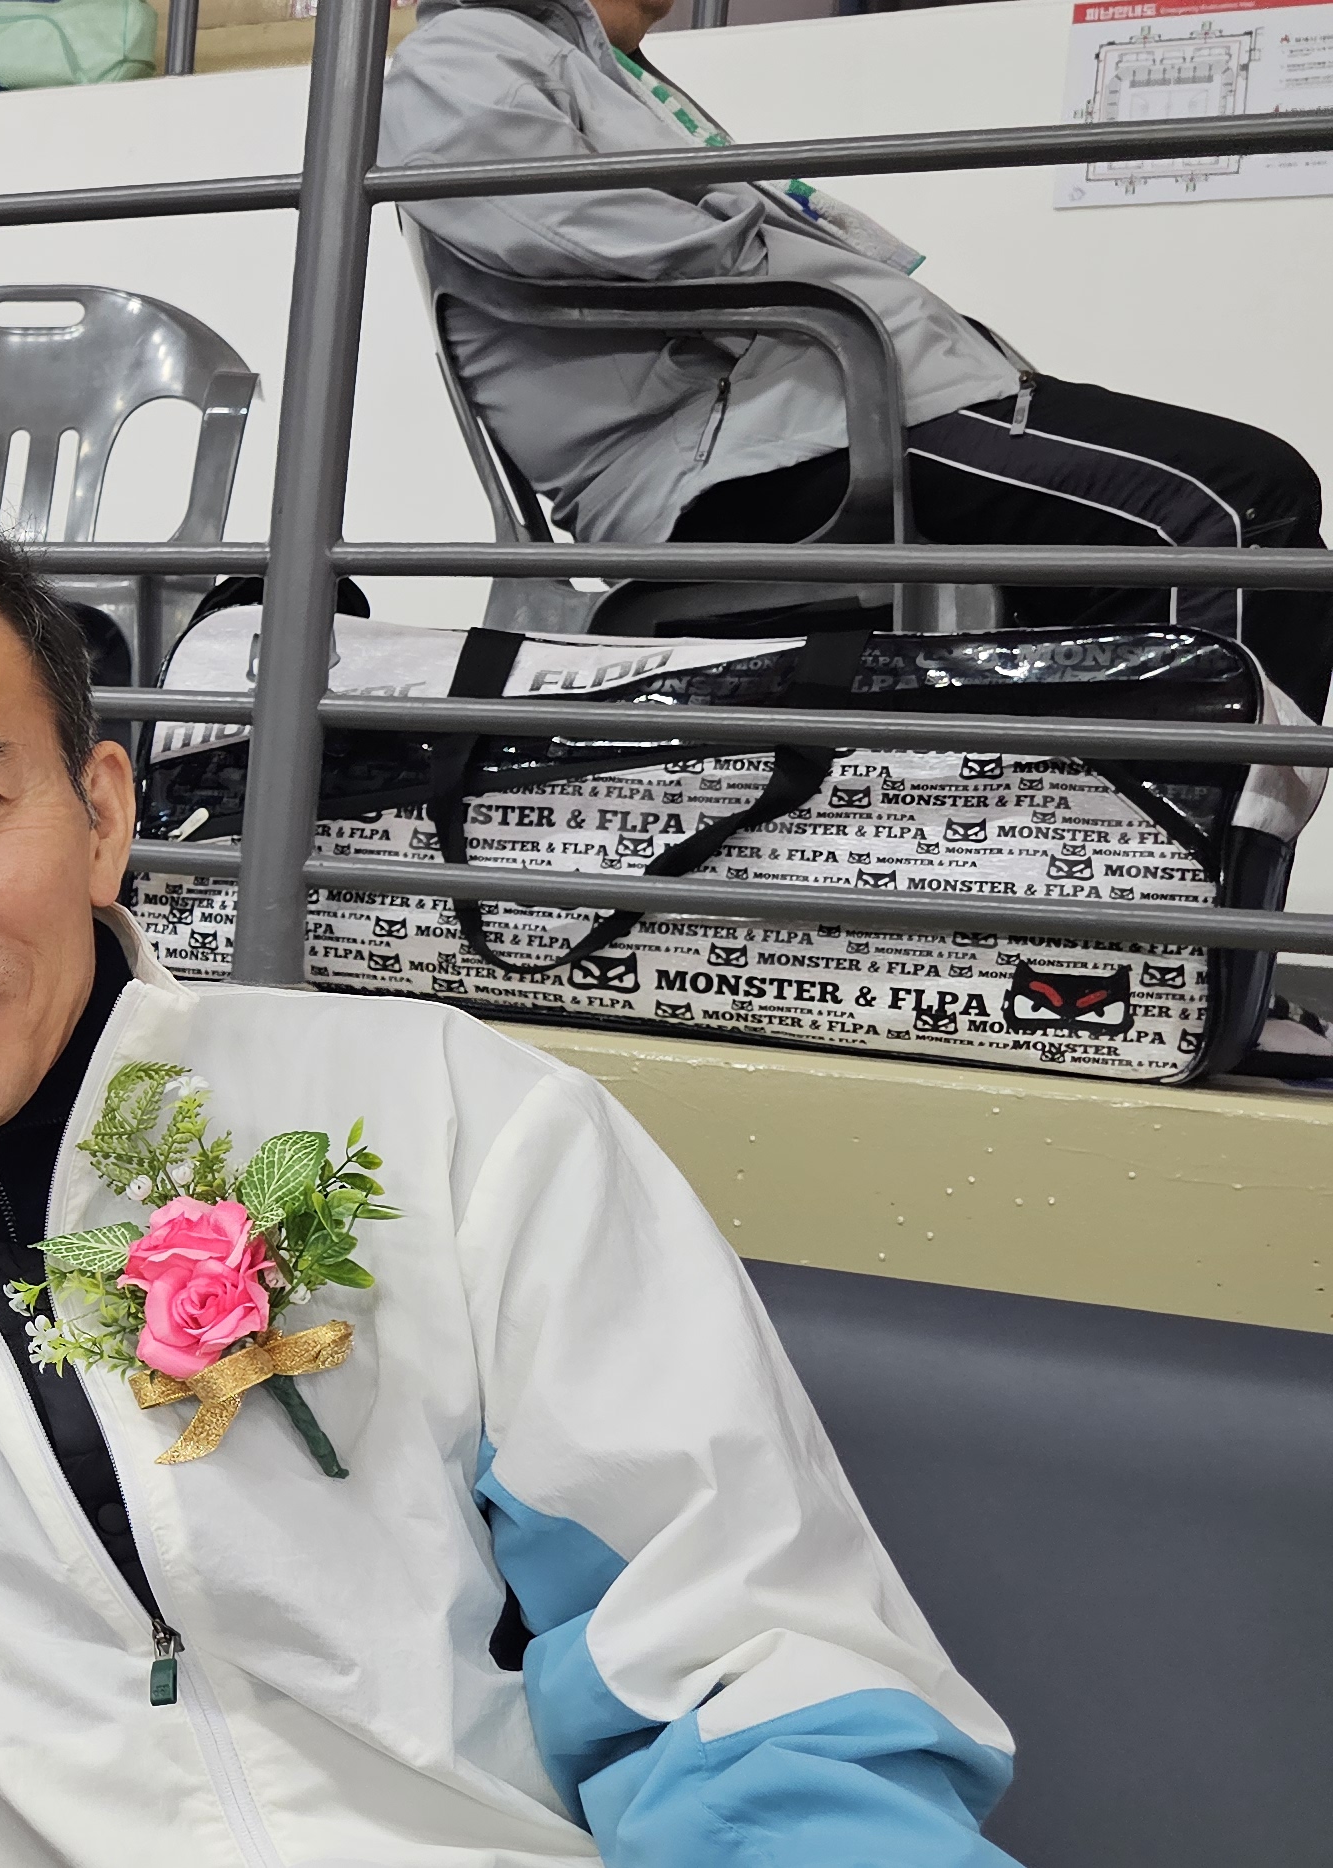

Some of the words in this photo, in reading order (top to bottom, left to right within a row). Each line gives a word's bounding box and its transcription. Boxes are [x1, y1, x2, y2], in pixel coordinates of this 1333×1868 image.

[1085, 3, 1157, 21] 피난안내도
[840, 764, 892, 778] FLPA
[657, 779, 682, 787] FLPA
[910, 783, 971, 792] MONSTER
[983, 783, 1011, 791] FLPA
[589, 786, 599, 797] &
[605, 787, 654, 801] FLPA
[687, 795, 742, 804] MONSTER
[880, 793, 989, 808] MONSTER
[995, 796, 1008, 808] &
[1014, 795, 1071, 810] FLPA
[566, 809, 585, 829] &
[596, 809, 685, 834] FLPA
[817, 811, 873, 820] MONSTER
[885, 814, 916, 822] FLPA
[1062, 817, 1123, 827] MONSTER
[336, 825, 343, 839] &
[348, 828, 391, 841] FLPA
[855, 825, 867, 838] &
[874, 825, 927, 840] FLPA
[997, 826, 1111, 843] MONSTER
[1118, 830, 1131, 844] &
[465, 836, 540, 853] ONSTER
[546, 842, 556, 853] &
[562, 842, 609, 857] FLPA
[945, 846, 1004, 855] MONSTER
[1019, 849, 1049, 857] FLPA
[1092, 849, 1155, 858] MONSTER
[529, 858, 552, 866] FLPA
[768, 848, 780, 860] &
[787, 849, 839, 863] FLPA
[876, 857, 934, 866] MONSTER
[937, 859, 944, 867] &
[948, 860, 977, 868] FLPA
[752, 871, 811, 883] MONSTER
[814, 875, 821, 883] &
[823, 876, 851, 885] FLPA
[907, 877, 1017, 895] MONSTER
[1024, 883, 1037, 895] &
[1044, 885, 1102, 899] FLPA
[219, 900, 228, 910] &
[328, 889, 411, 908] MONSTER
[415, 899, 425, 909] &
[349, 913, 371, 921] FLPA
[503, 907, 553, 917] MONSTER
[566, 912, 590, 921] FLPA
[145, 922, 178, 936] FLPA
[523, 923, 547, 932] FLPA
[638, 921, 738, 939] MONSTER
[744, 929, 756, 941] &
[762, 930, 813, 945] FLPA
[313, 935, 357, 945] MONSTER
[368, 939, 391, 947] FLPA
[510, 934, 521, 945] &
[528, 935, 571, 950] FLPA
[845, 930, 904, 941] MONSTER
[916, 935, 946, 944] FLPA
[309, 946, 318, 957] &
[323, 947, 364, 961] FLPA
[609, 941, 662, 952] MONSTER
[673, 947, 700, 955] FLPA
[874, 946, 934, 957] MONSTER
[947, 952, 978, 961] FLPA
[757, 952, 861, 972] MONSTER
[868, 960, 880, 973] &
[886, 962, 941, 978] FLPA
[1027, 957, 1090, 969] MONSTER
[409, 961, 497, 979] MONSTER
[518, 972, 564, 986] FLPA
[474, 985, 566, 1003] MONSTER
[571, 995, 581, 1005] &
[587, 996, 635, 1010] FLPA
[655, 968, 843, 1004] MONSTER
[855, 985, 877, 1008] &
[888, 986, 991, 1018] FLPA
[758, 1003, 813, 1015] MONSTER
[817, 1008, 824, 1016] &
[827, 1010, 855, 1019] FLPA
[1179, 1006, 1190, 1020] &
[701, 1009, 804, 1029] MONSTER
[809, 1018, 821, 1031] &
[827, 1020, 881, 1036] FLPA
[915, 1033, 974, 1047] MONSTER
[1011, 1039, 1121, 1057] MONSTER
[1070, 1055, 1134, 1067] MONSTER
[1148, 1060, 1178, 1070] FLPA
